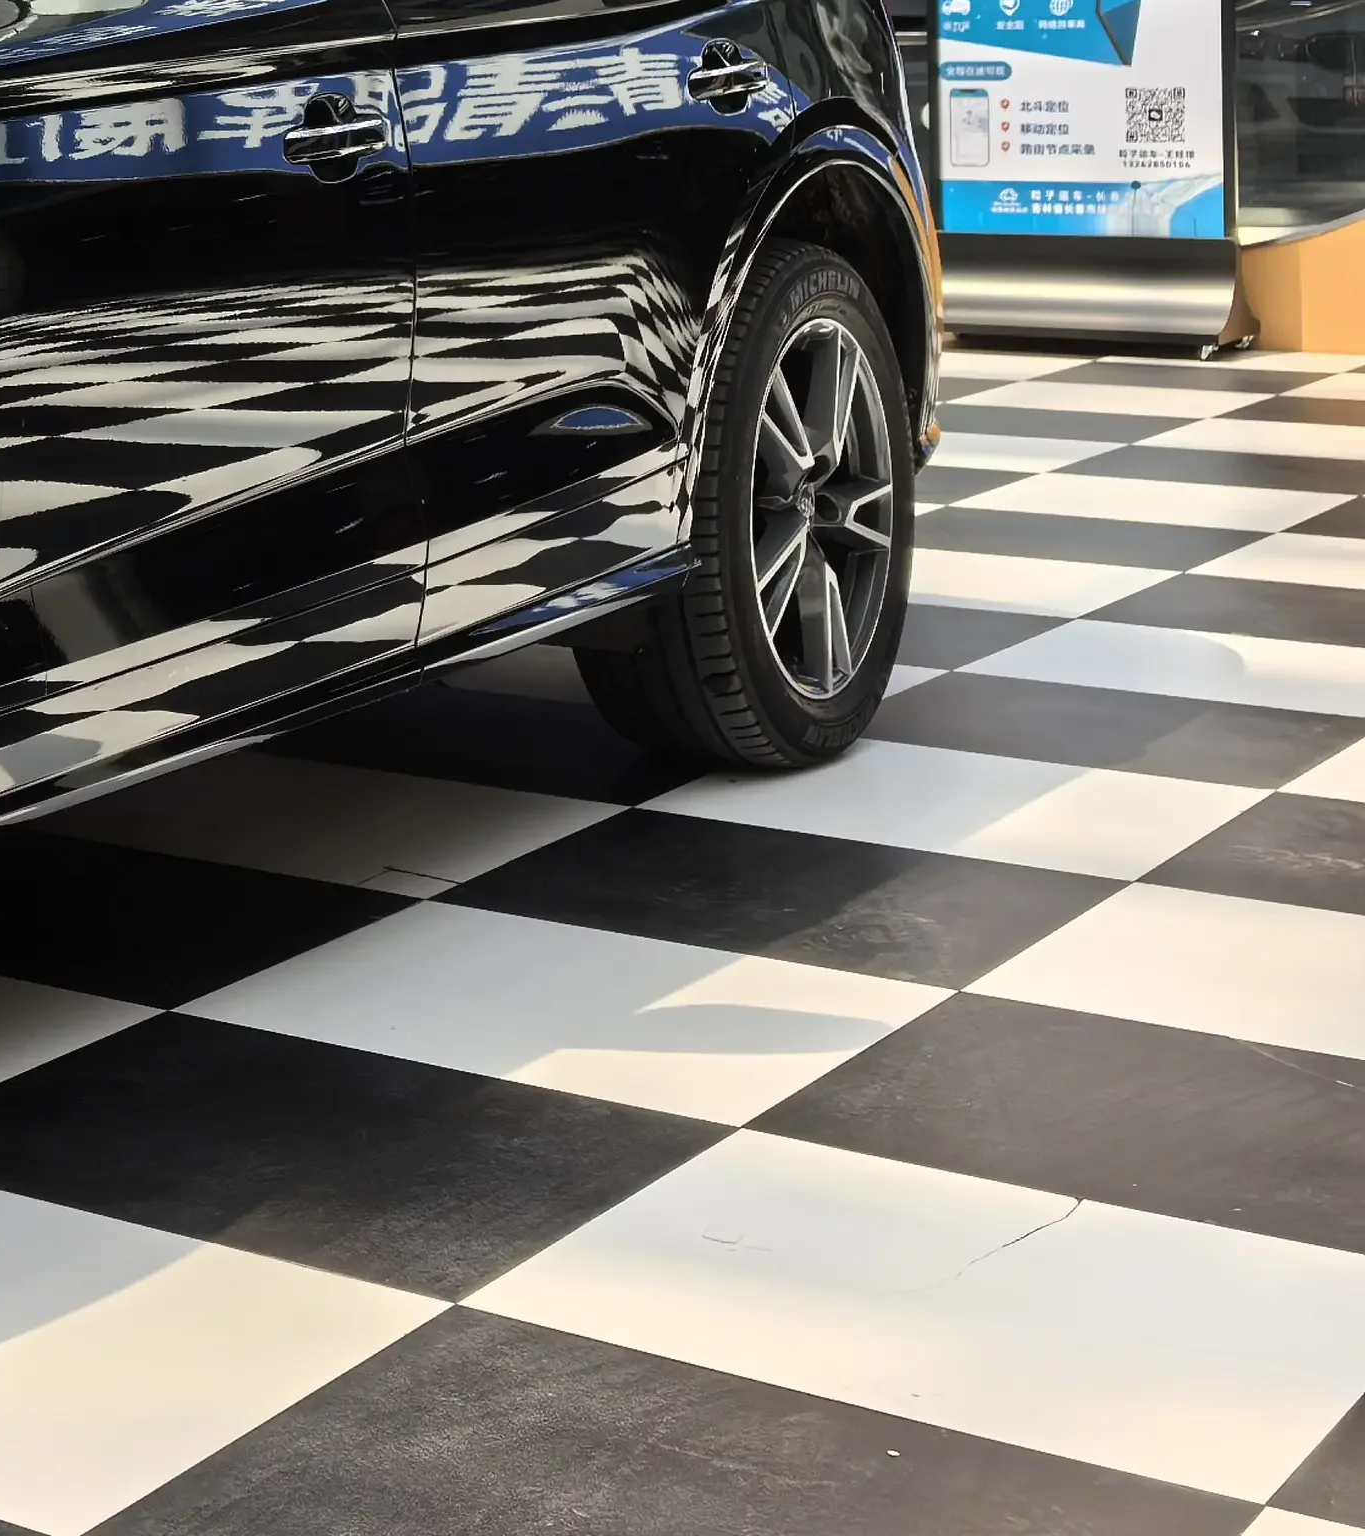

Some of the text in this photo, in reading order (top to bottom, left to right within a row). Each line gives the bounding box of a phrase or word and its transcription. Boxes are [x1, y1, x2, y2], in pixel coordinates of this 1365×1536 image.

[1020, 100, 1070, 113] 北斗定位
[1020, 123, 1070, 135] 移动定位
